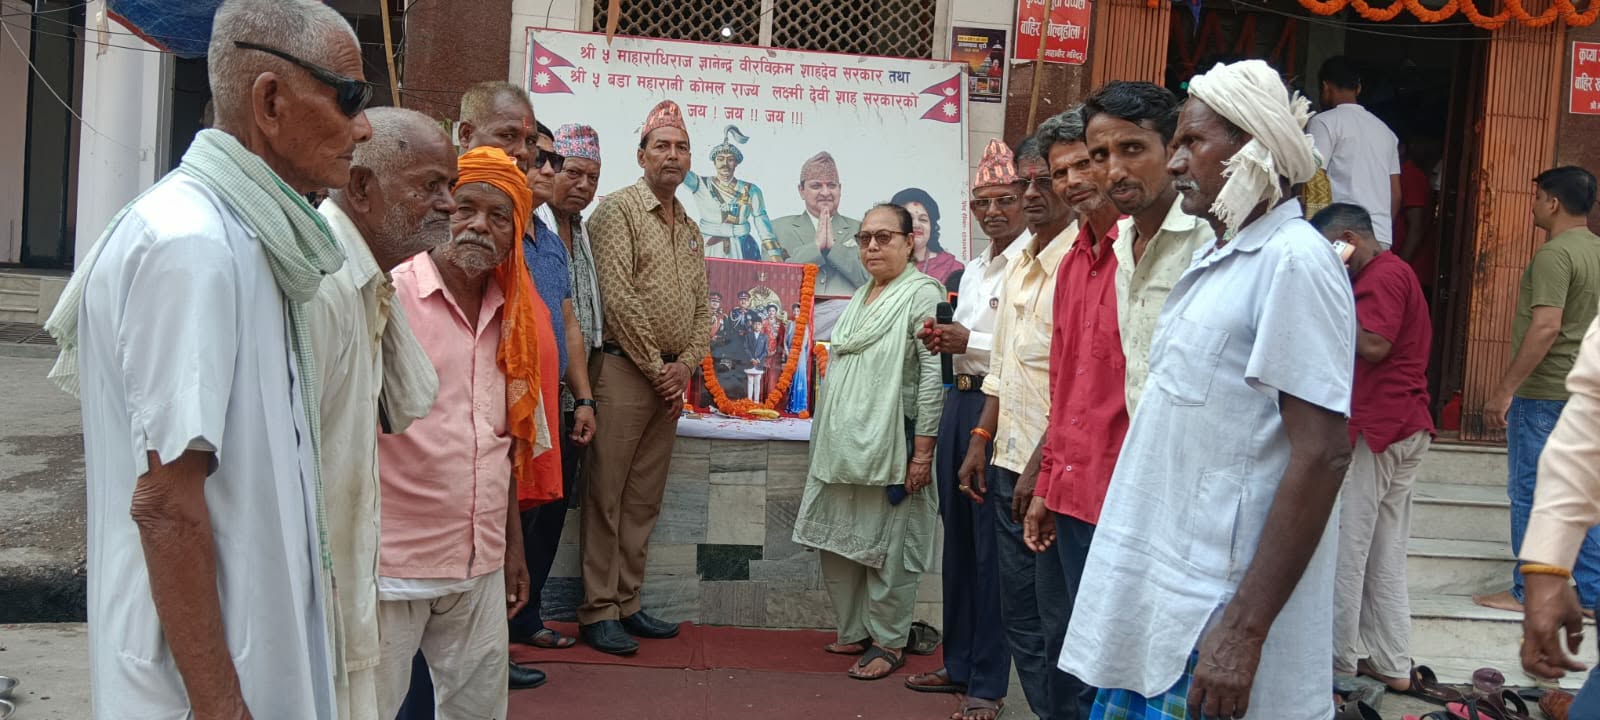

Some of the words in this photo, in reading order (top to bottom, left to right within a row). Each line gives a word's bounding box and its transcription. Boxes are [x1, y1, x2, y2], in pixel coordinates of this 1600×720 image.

[580, 42, 597, 60] श्री
[617, 48, 694, 69] माहाराधिराज
[698, 54, 734, 73] ज्ञानेन्द्र
[739, 55, 795, 76] वीरविक्रम
[800, 61, 838, 81] शाहदेव
[842, 67, 884, 85] सरकार
[888, 70, 911, 84] तथा
[570, 66, 587, 84] श्री
[637, 74, 684, 93] महारानी
[689, 77, 726, 96] कोमल
[731, 82, 761, 98] राज्य
[772, 83, 804, 101] लक्ष्मी
[809, 85, 830, 105] देवी
[835, 90, 857, 109] शाह
[863, 91, 919, 109] सरकारको
[687, 103, 708, 119] जय
[724, 106, 745, 121] जय
[765, 109, 785, 125] जय
